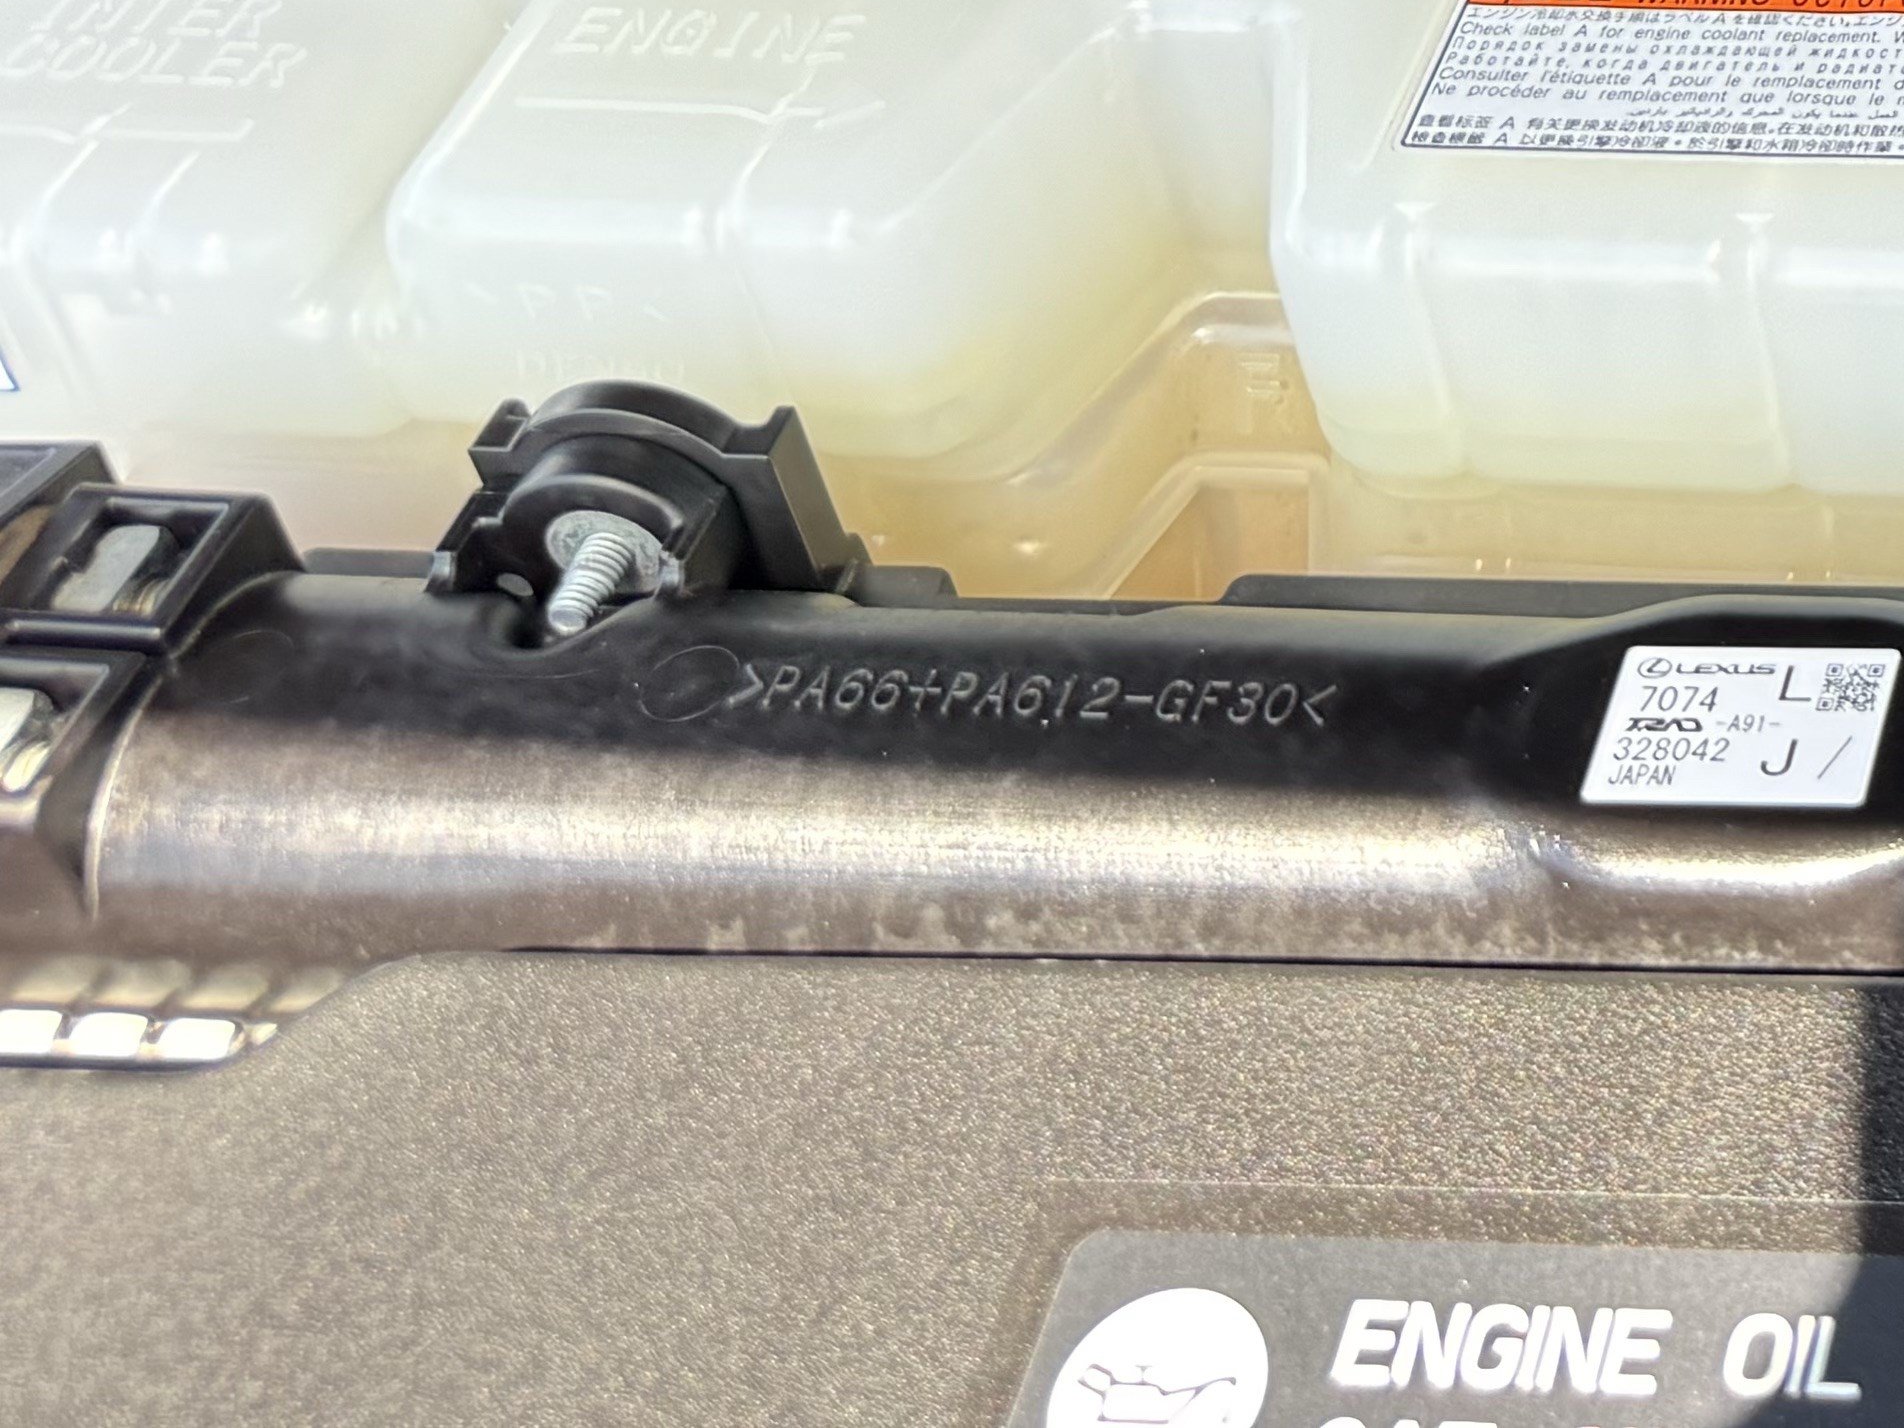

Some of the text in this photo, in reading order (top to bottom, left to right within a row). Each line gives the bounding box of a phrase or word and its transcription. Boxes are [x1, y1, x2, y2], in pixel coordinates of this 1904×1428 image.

[554, 6, 865, 66] ENGINE
[1459, 21, 1513, 37] Check
[1523, 23, 1566, 37] label
[1573, 24, 1588, 37] A
[1599, 25, 1625, 39] for
[1634, 27, 1691, 41] engine
[1701, 28, 1765, 41] coolant
[1775, 30, 1880, 44] replacement.
[0, 33, 308, 89] COOLER
[1431, 82, 1457, 95] Ne
[1466, 84, 1551, 99] procéder
[1562, 89, 1587, 100] au
[1599, 89, 1727, 103] remplacement
[1739, 92, 1775, 104] que
[1786, 90, 1856, 106] lorsque
[1868, 92, 1885, 106] le
[1439, 67, 1529, 82] Consulter
[1540, 70, 1631, 85] l'étiquette
[1641, 72, 1656, 86] A
[1668, 75, 1713, 87] pour
[1724, 73, 1742, 88] le
[1753, 76, 1881, 90] remplacement
[1676, 663, 1812, 702] LEXUS L
[1640, 686, 1718, 712] 7074
[1613, 737, 1798, 776] 328042 J
[1608, 764, 1676, 785] JAPAN
[1330, 1298, 1862, 1402] ENGINE OIL
